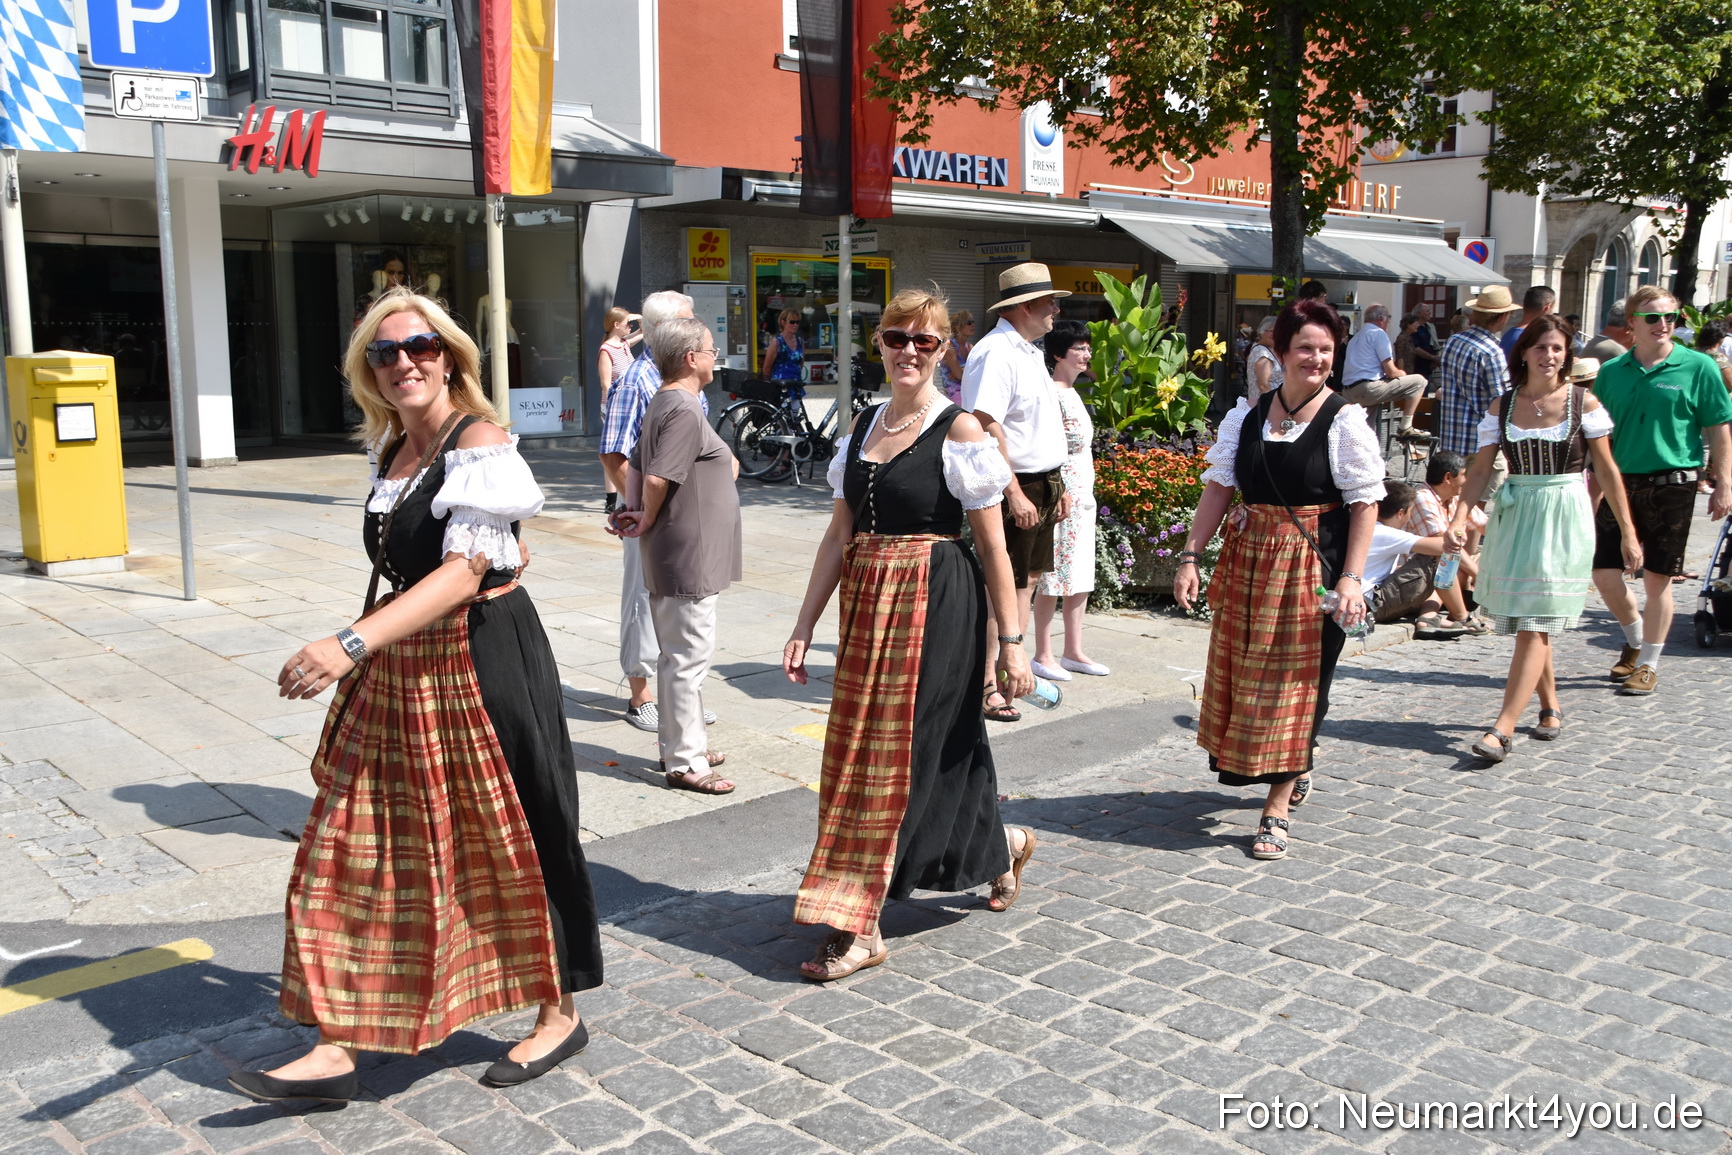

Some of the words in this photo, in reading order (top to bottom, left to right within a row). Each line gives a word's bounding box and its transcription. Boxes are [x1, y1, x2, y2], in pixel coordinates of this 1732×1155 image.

[116, 0, 180, 54] P
[144, 93, 175, 102] Parkausweis
[171, 103, 193, 112] Fahrzeug
[225, 104, 327, 178] H&M
[1032, 159, 1057, 173] PRESSE
[1030, 174, 1060, 188] THUMANN
[851, 236, 875, 244] BAYERISCHE
[959, 240, 968, 249] 41
[981, 243, 1026, 255] NEUMARKTER
[692, 256, 726, 269] LOTTO
[519, 399, 555, 411] SEASON
[526, 409, 549, 418] preview
